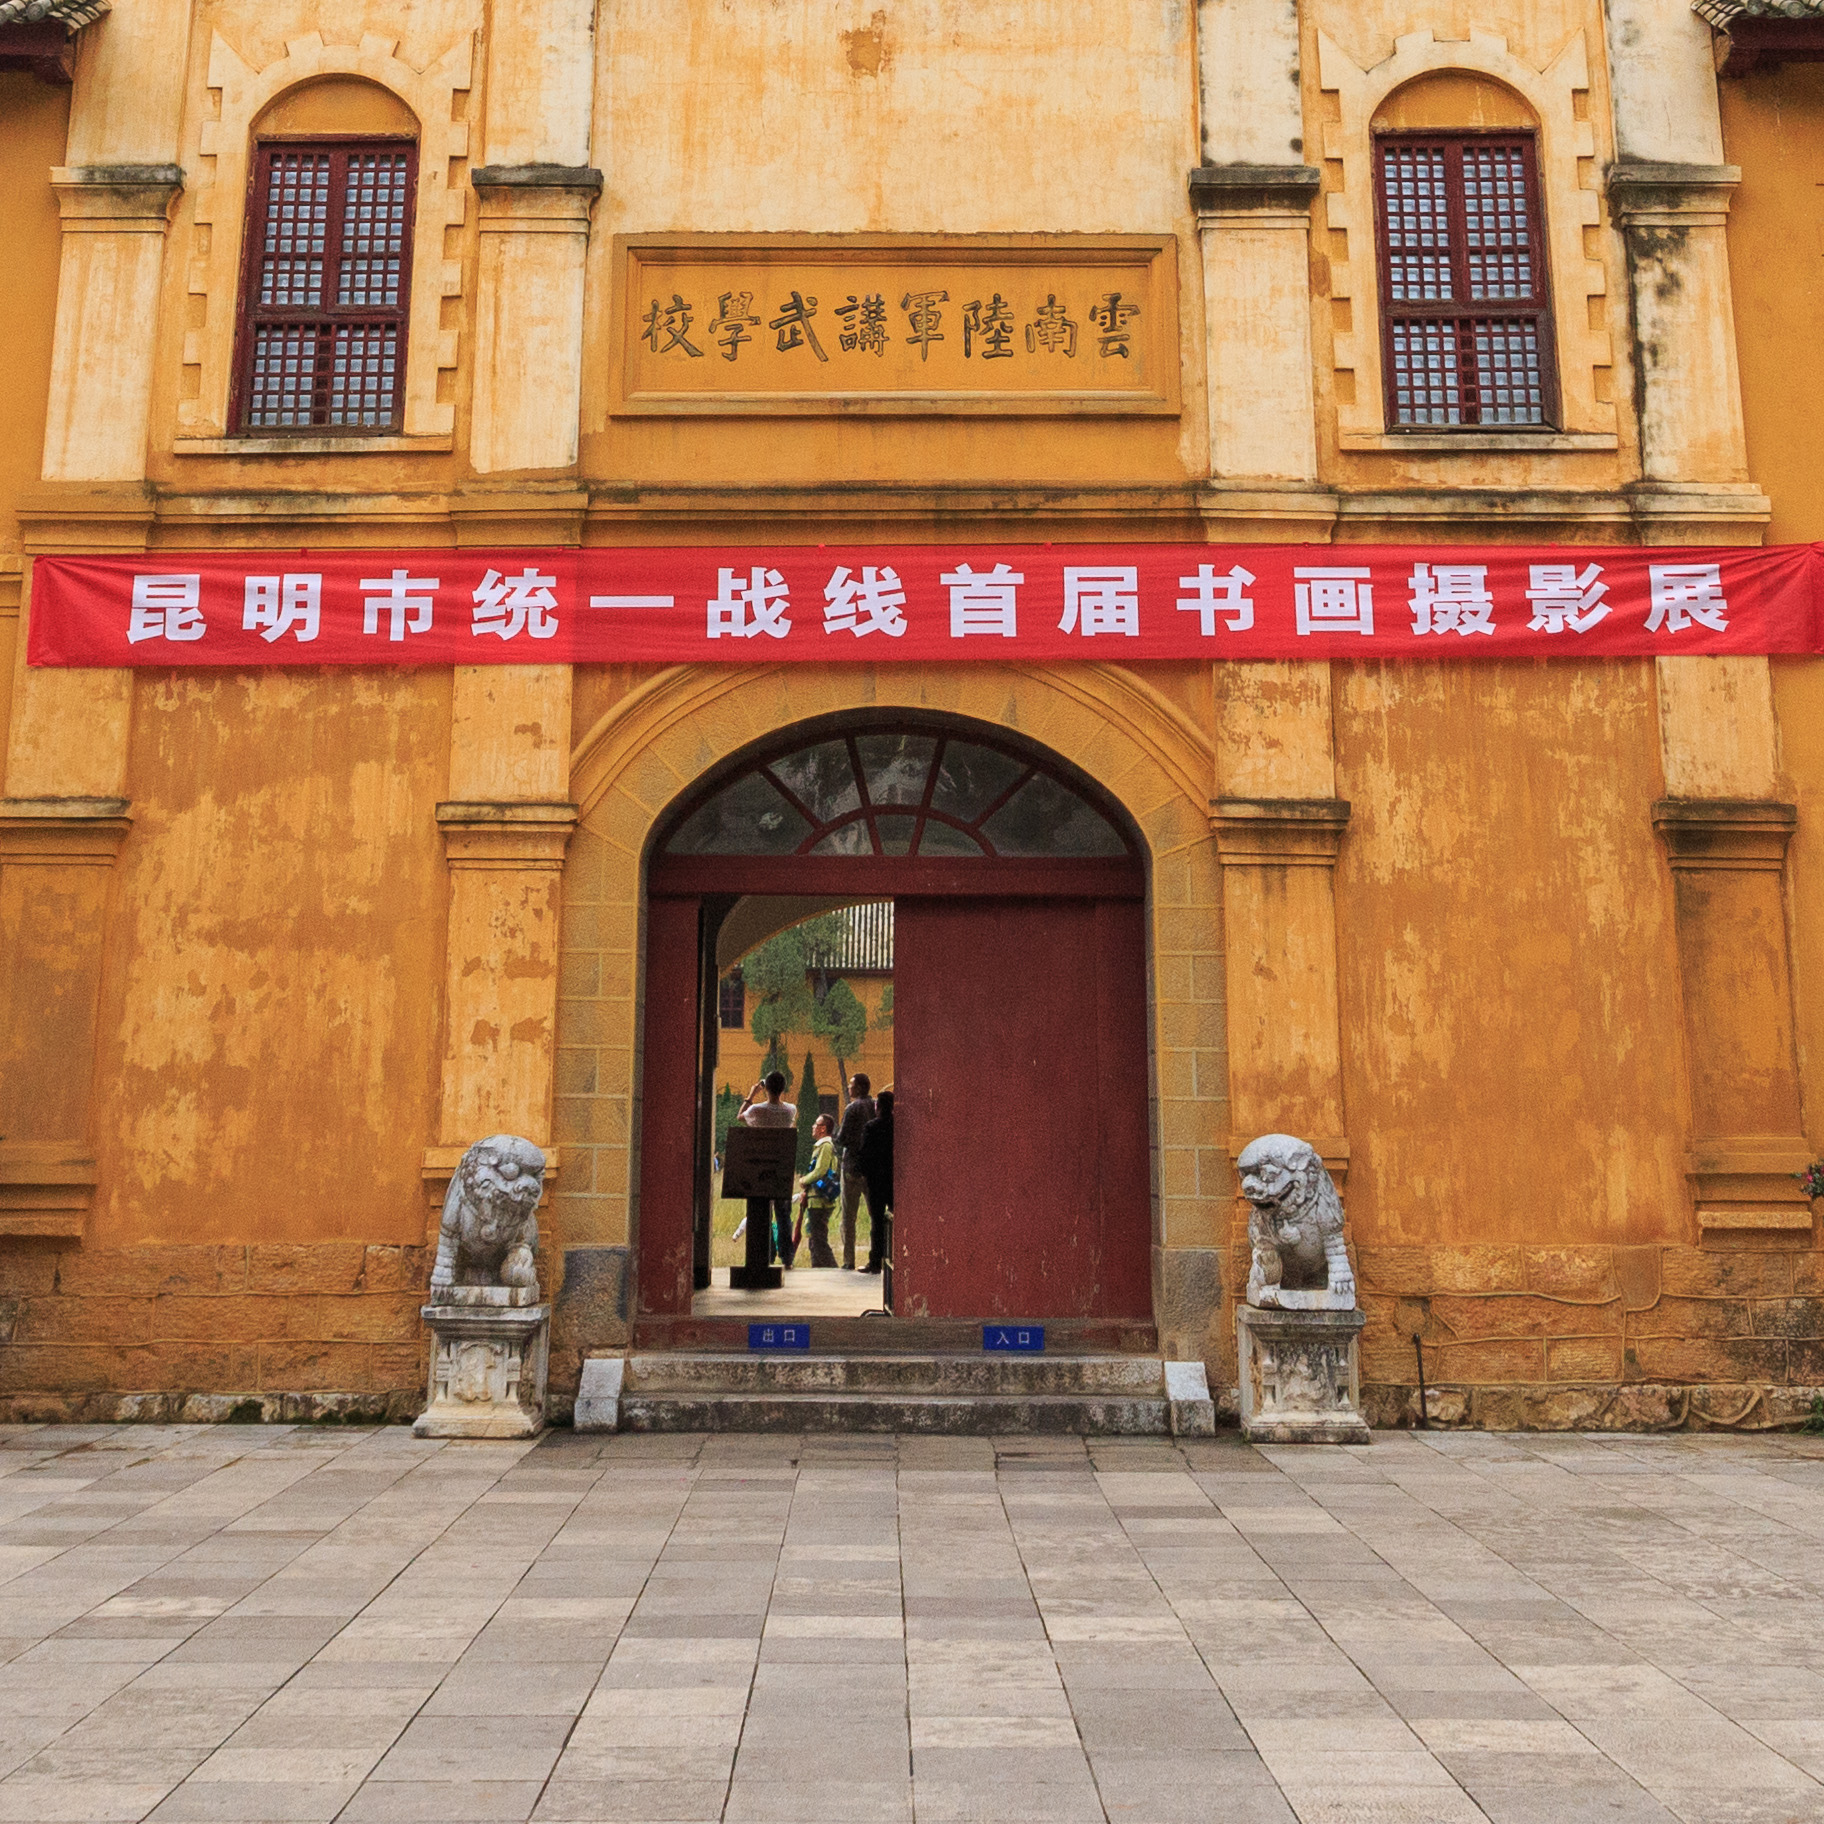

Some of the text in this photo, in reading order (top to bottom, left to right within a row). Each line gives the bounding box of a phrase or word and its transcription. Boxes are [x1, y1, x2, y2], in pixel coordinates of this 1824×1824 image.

[126, 562, 1730, 645] 昆明市统一战线首届书画摄影展
[762, 1328, 796, 1343] 出口
[996, 1331, 1030, 1345] 入口
